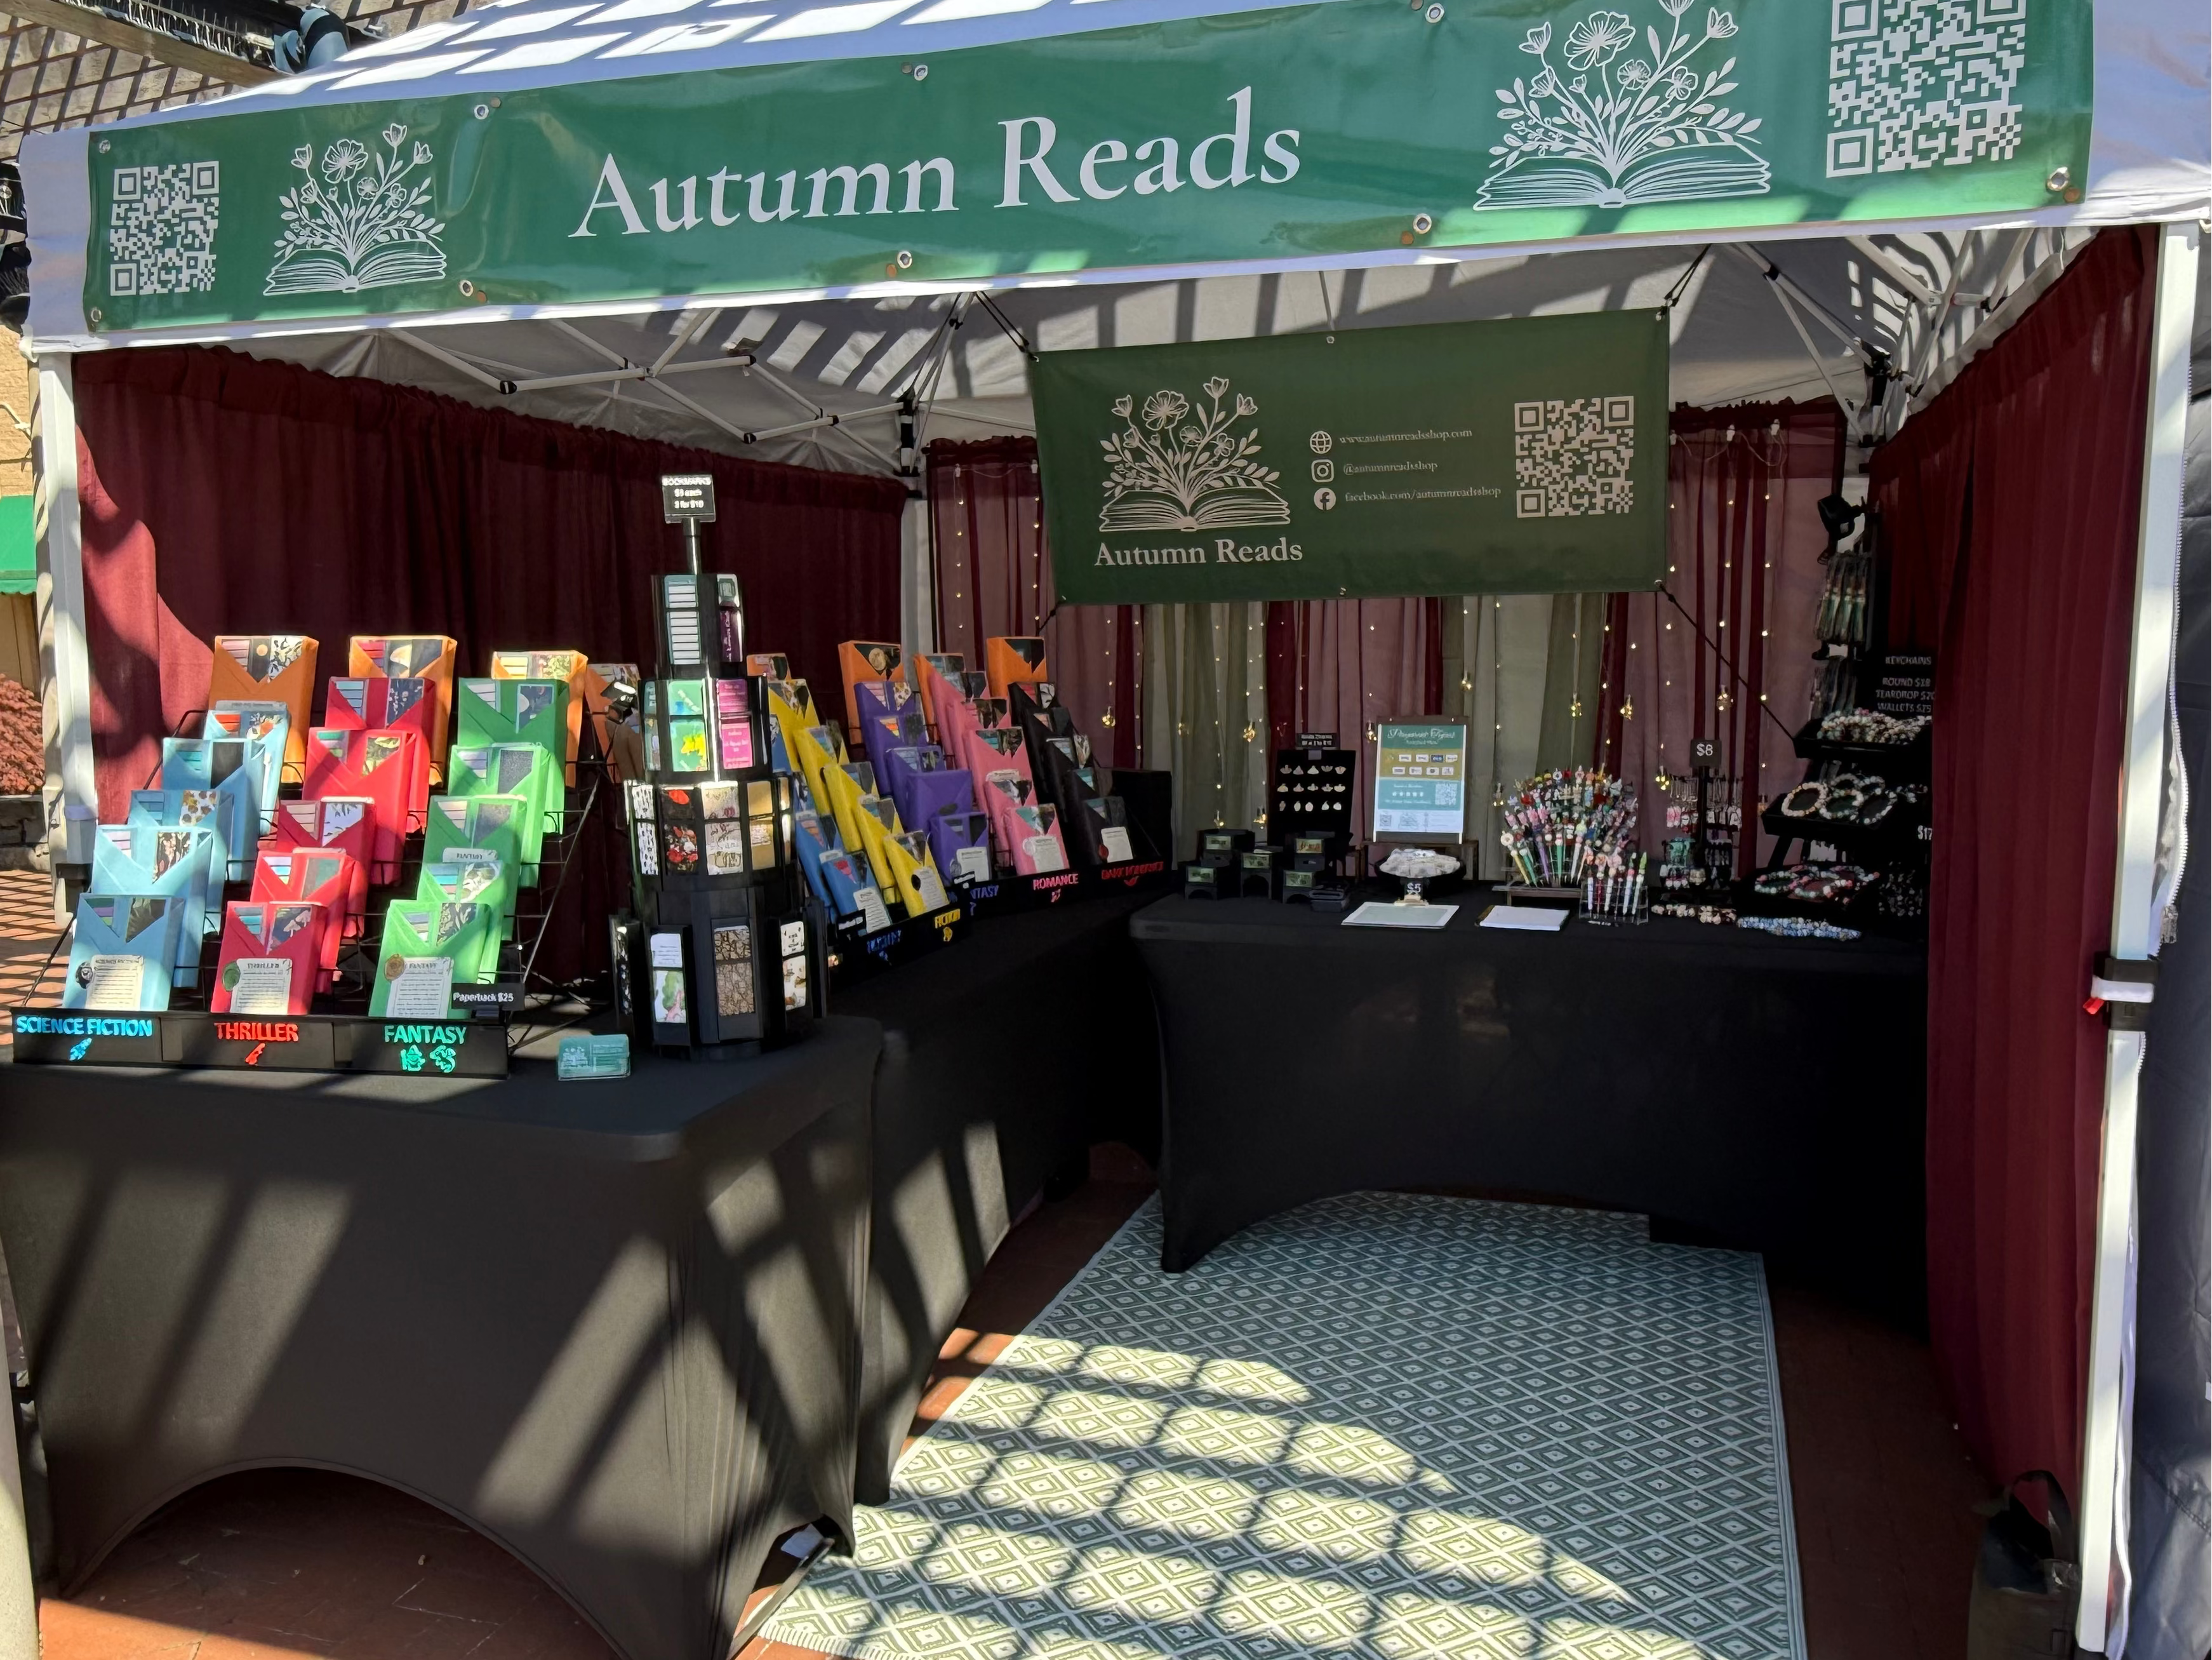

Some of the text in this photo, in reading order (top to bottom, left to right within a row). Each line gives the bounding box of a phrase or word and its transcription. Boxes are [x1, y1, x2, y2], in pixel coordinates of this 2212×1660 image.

[569, 86, 1300, 238] Autumn Reads
[1095, 537, 1303, 566] Autumn Reads
[1885, 656, 1931, 665] KEYCHAINS
[1882, 677, 1913, 686] ROUND
[1876, 690, 1919, 699] TEARDROP
[1877, 702, 1914, 711] WALLETS
[1696, 743, 1713, 756] $8
[1032, 874, 1079, 890] ROMANCE
[1407, 883, 1421, 894] $5
[453, 992, 514, 1003] Paperback $25
[17, 1016, 153, 1037] SCIENCE FICTION
[214, 1022, 299, 1042] THRILLER
[384, 1024, 467, 1044] FANTASY
